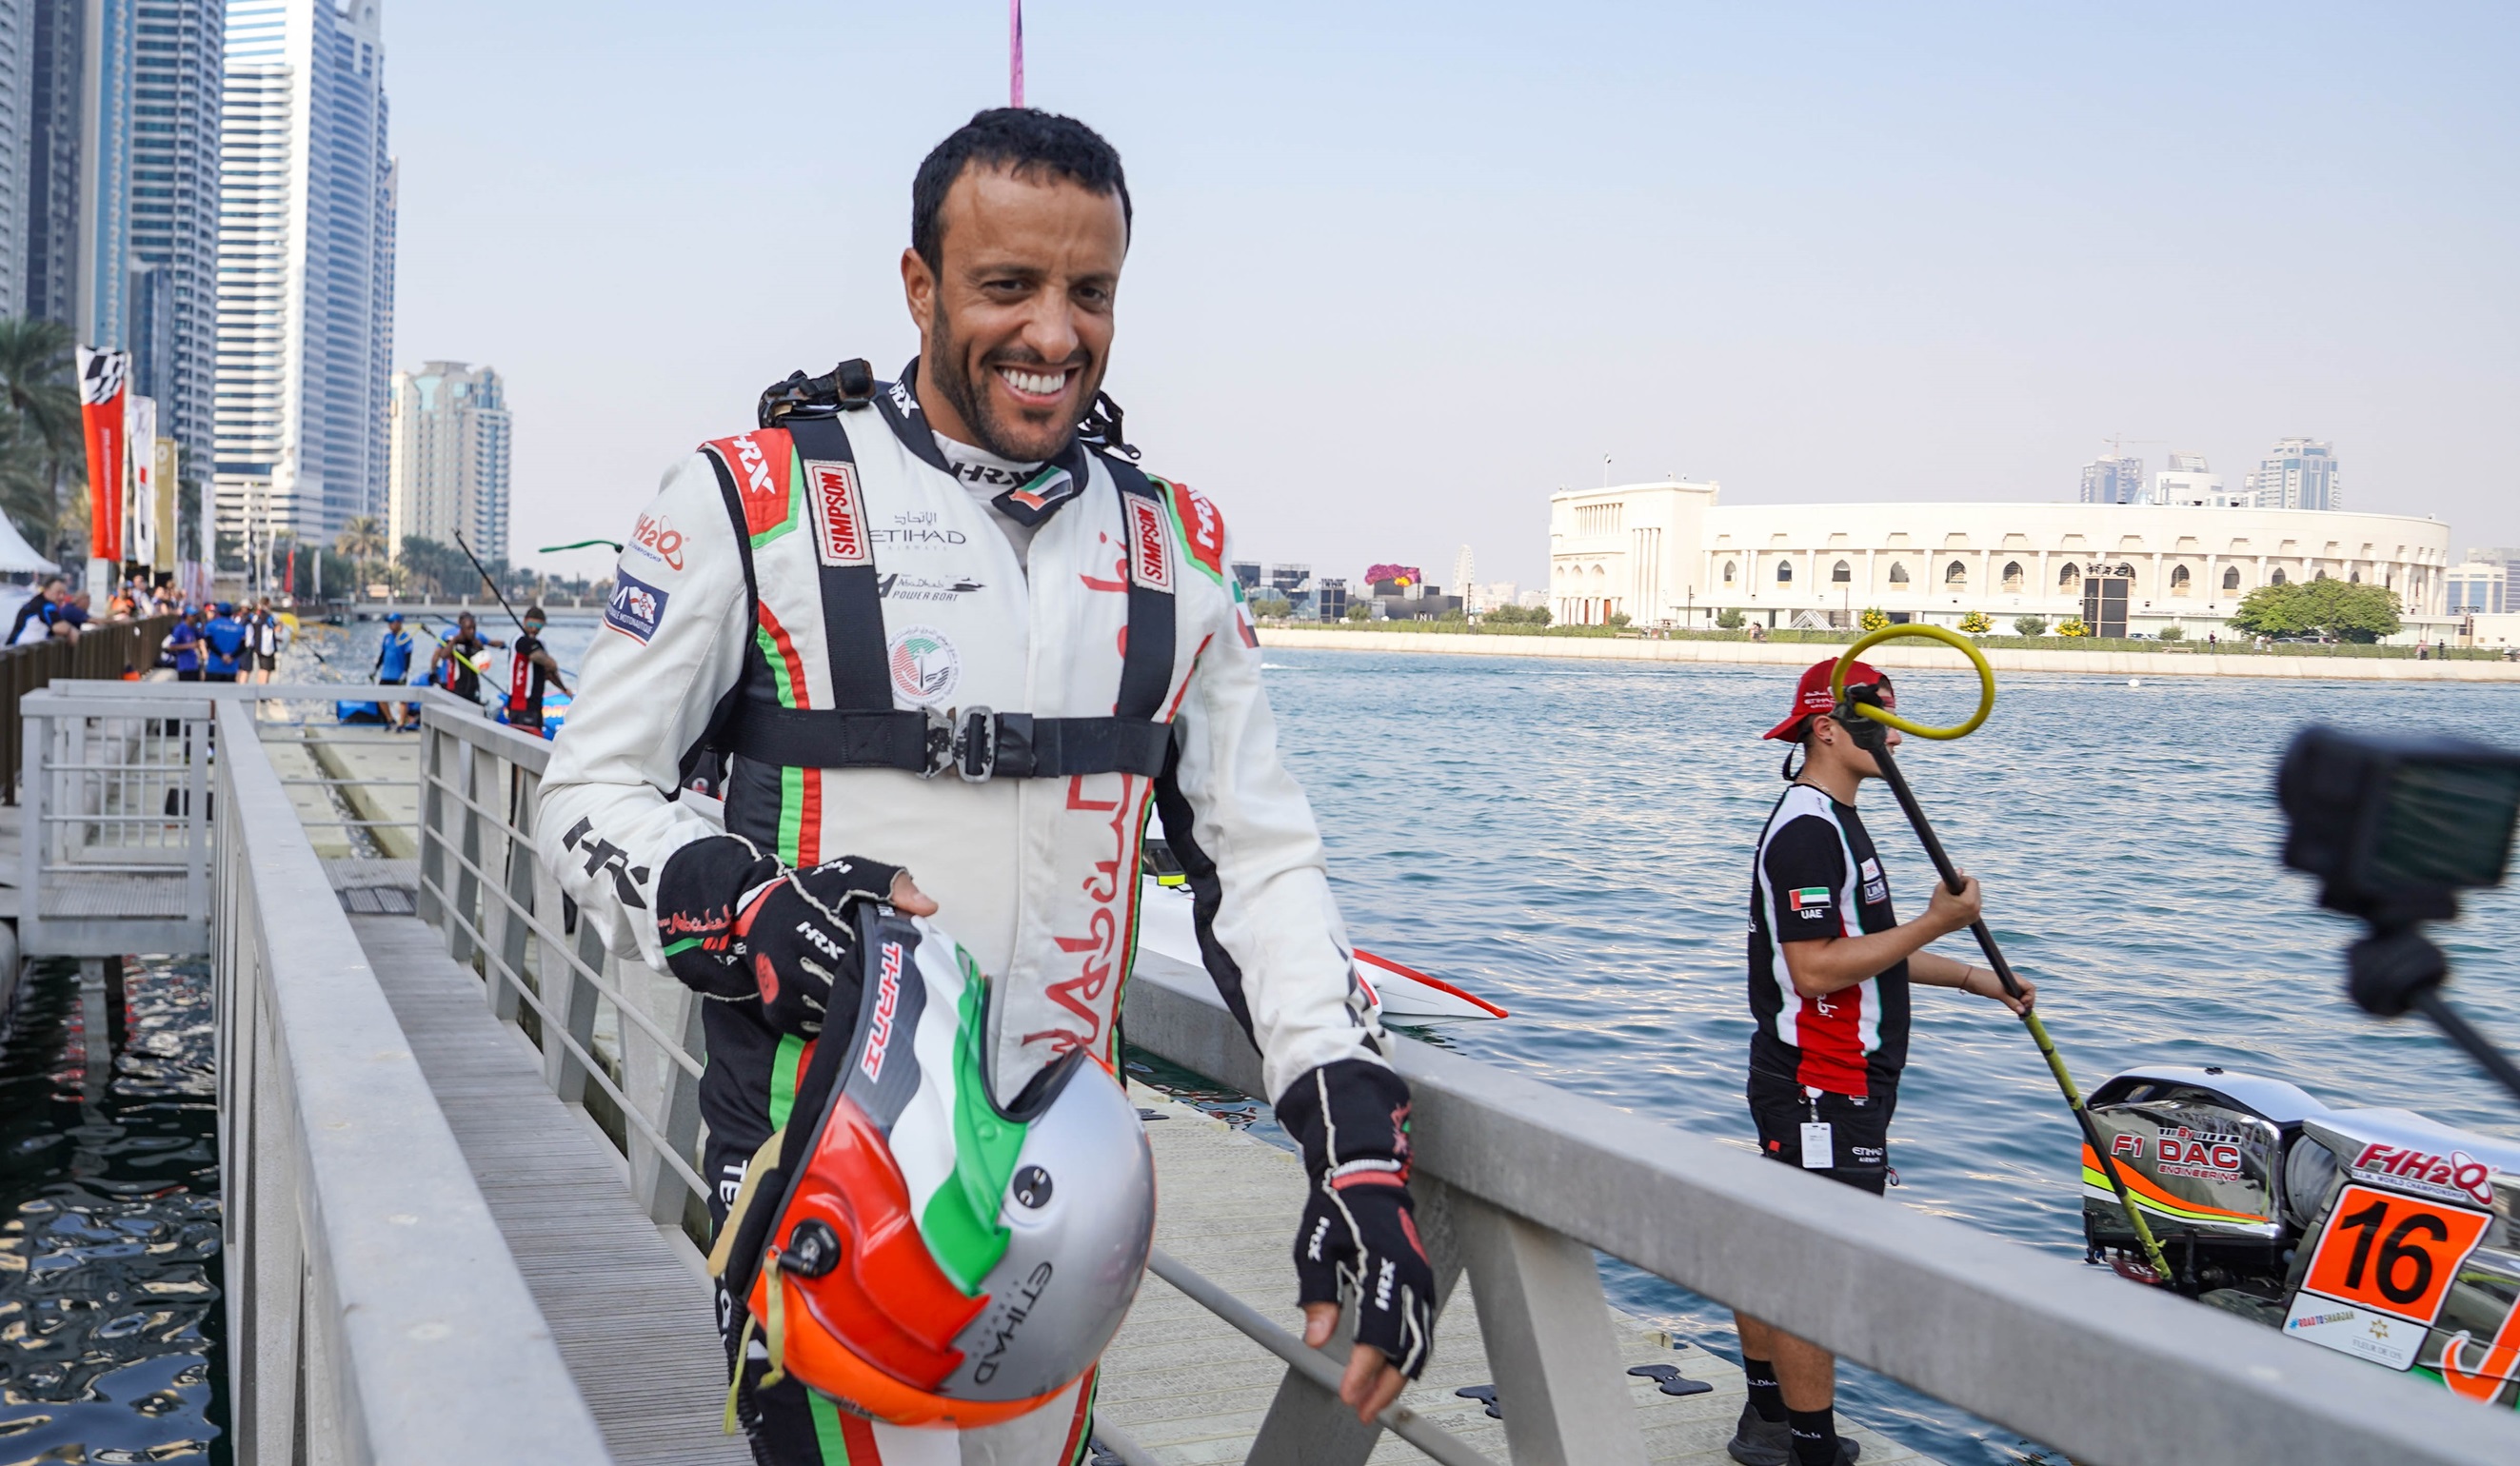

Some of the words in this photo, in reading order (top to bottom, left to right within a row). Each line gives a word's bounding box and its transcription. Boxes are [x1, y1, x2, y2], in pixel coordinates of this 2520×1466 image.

[731, 433, 776, 495] HRX
[821, 471, 856, 555] SIMPSON
[869, 529, 966, 545] ETIHAD
[1137, 506, 1162, 581] SIMPSON
[892, 590, 929, 601] POWER
[932, 592, 960, 603] BOAT
[1800, 908, 1824, 920] UAE
[796, 921, 846, 961] HRX
[2112, 1134, 2145, 1158] F1
[2158, 1139, 2239, 1170] DAC
[2177, 1126, 2195, 1140] By
[2157, 1164, 2240, 1182] ENGINEERING
[2377, 1175, 2404, 1188] WORLD
[2406, 1179, 2466, 1199] CHAMPIONSHIP
[2339, 1200, 2448, 1305] 16
[1374, 1257, 1397, 1312] HRX
[974, 1261, 1053, 1385] ETIHAD
